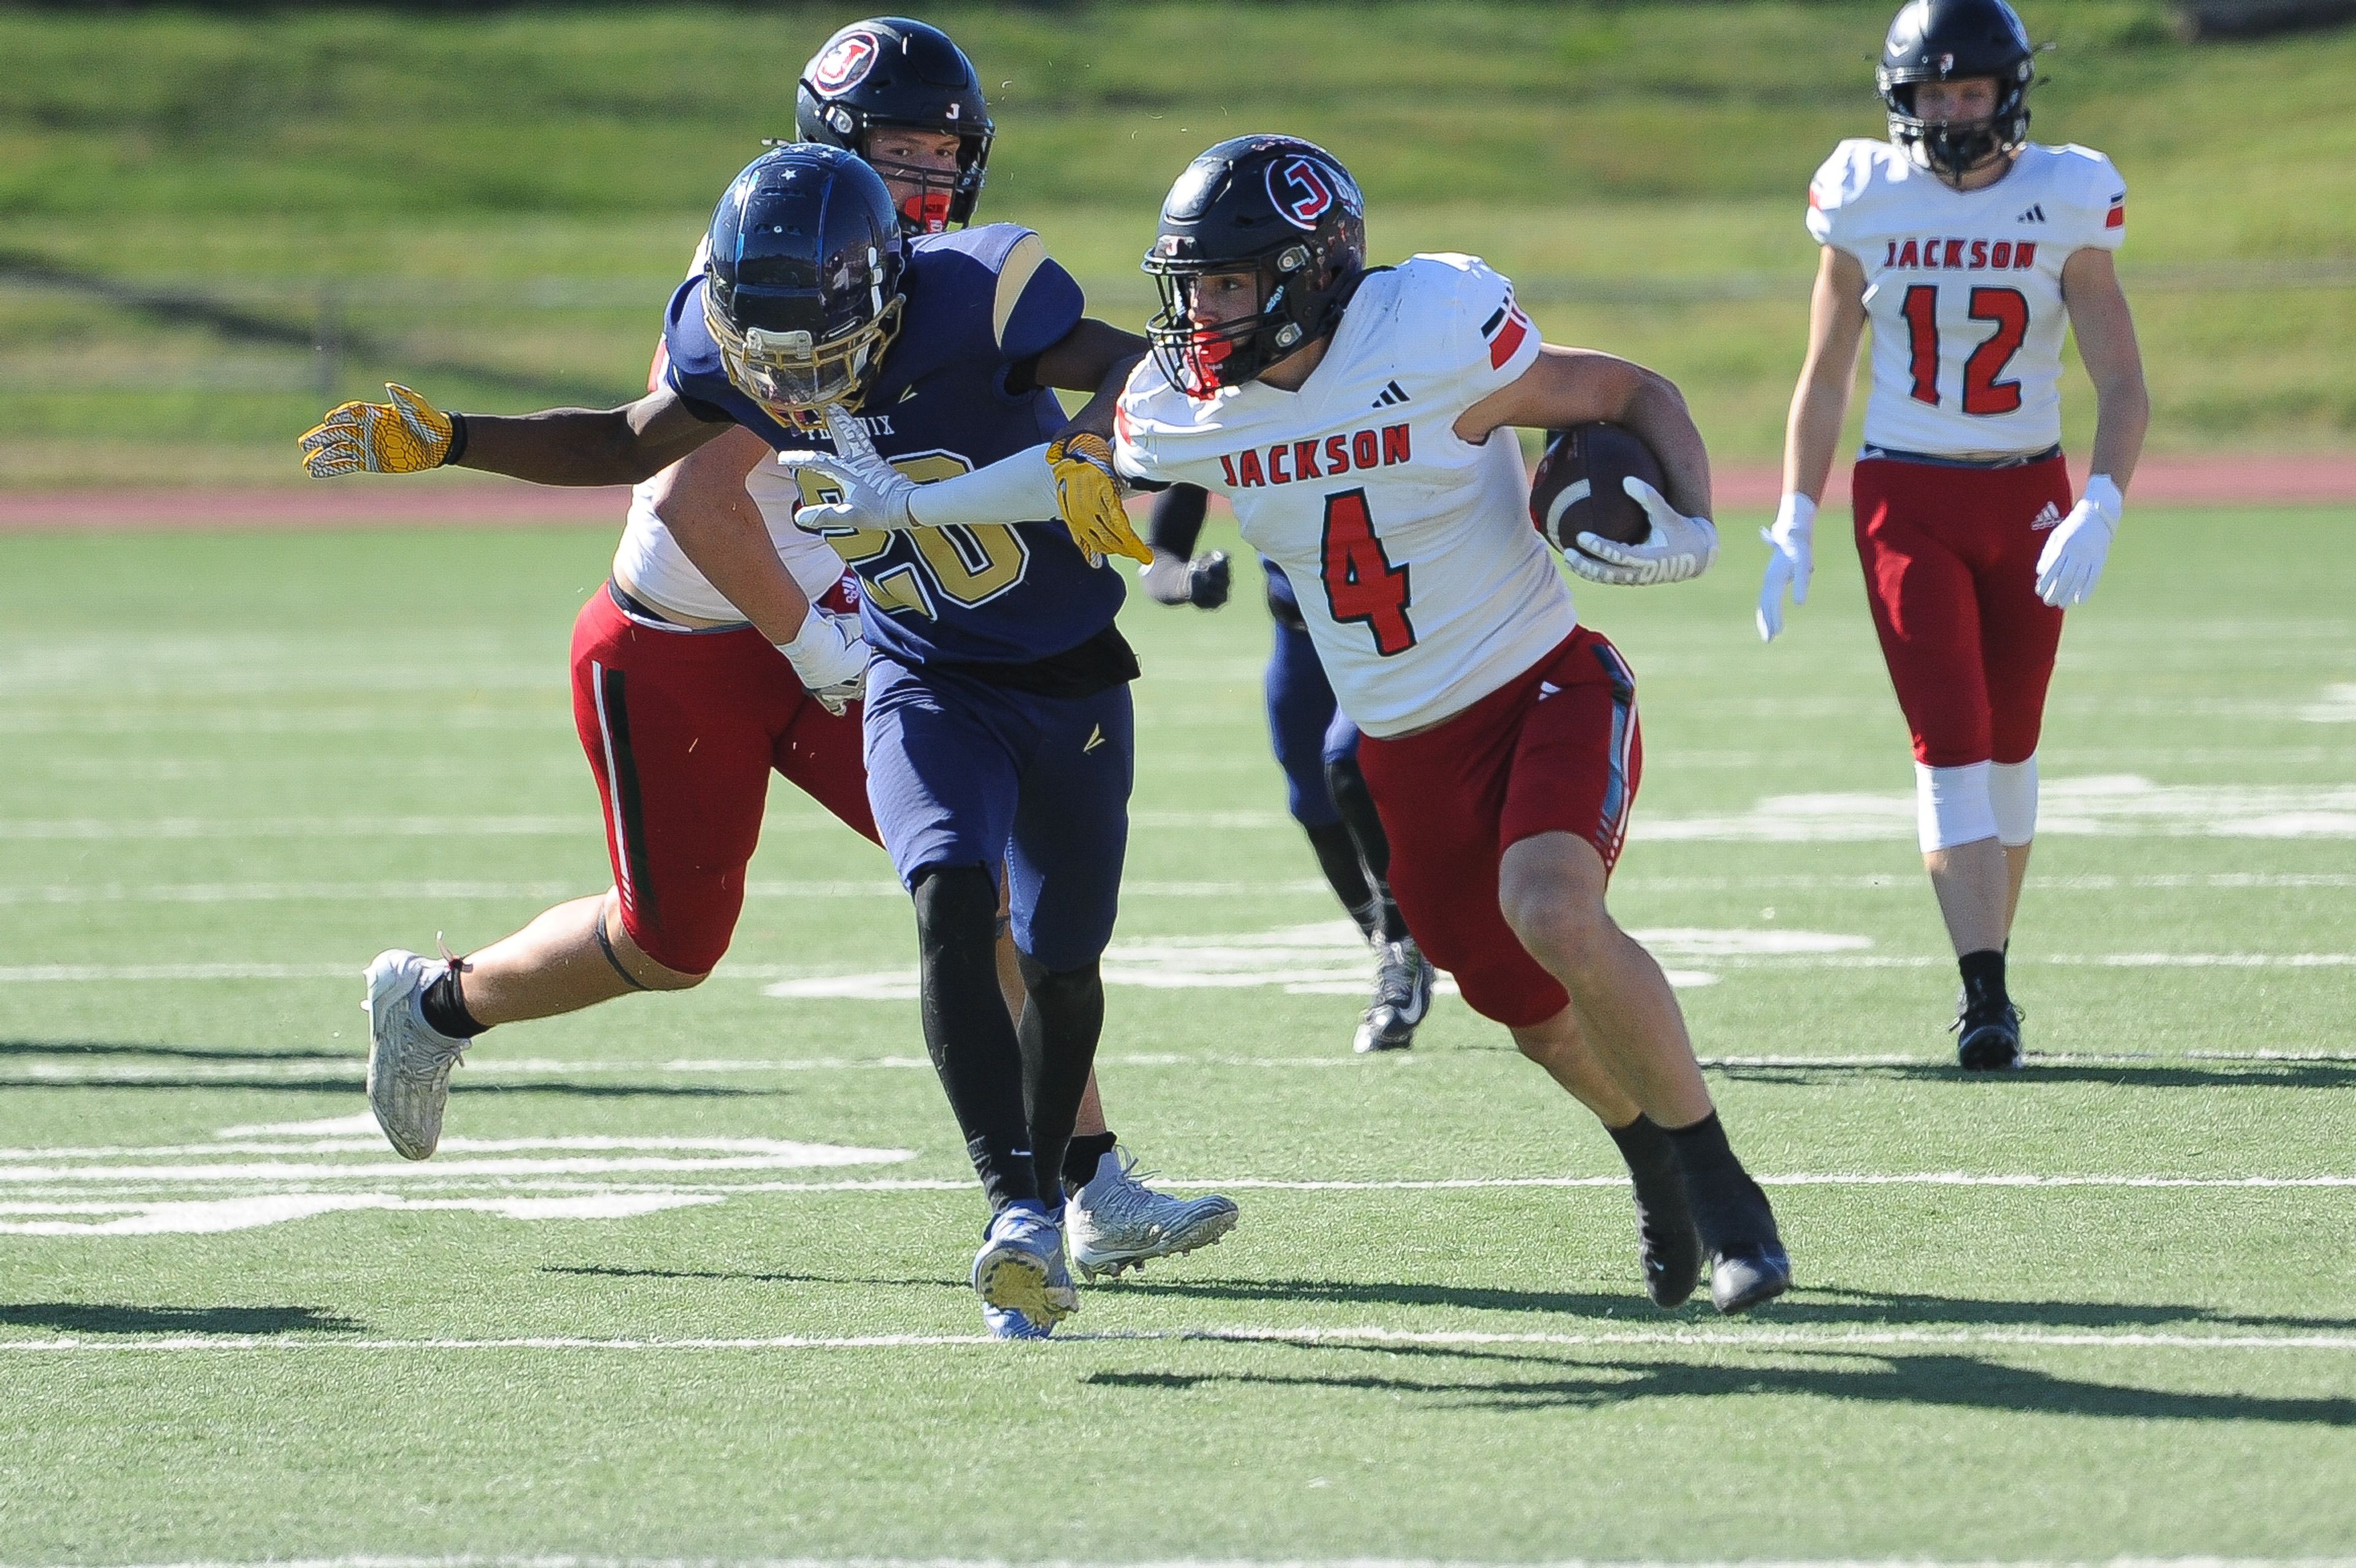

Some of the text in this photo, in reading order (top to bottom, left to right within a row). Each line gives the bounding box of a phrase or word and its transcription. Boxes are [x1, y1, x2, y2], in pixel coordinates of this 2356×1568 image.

[817, 38, 872, 85] J
[946, 103, 960, 119] J
[1284, 159, 1333, 220] J
[1884, 239, 2037, 269] JACKSON
[1900, 283, 2030, 415] 12
[806, 415, 895, 440] HNIX
[1220, 423, 1411, 488] JACKSON
[1320, 486, 1418, 657] 4
